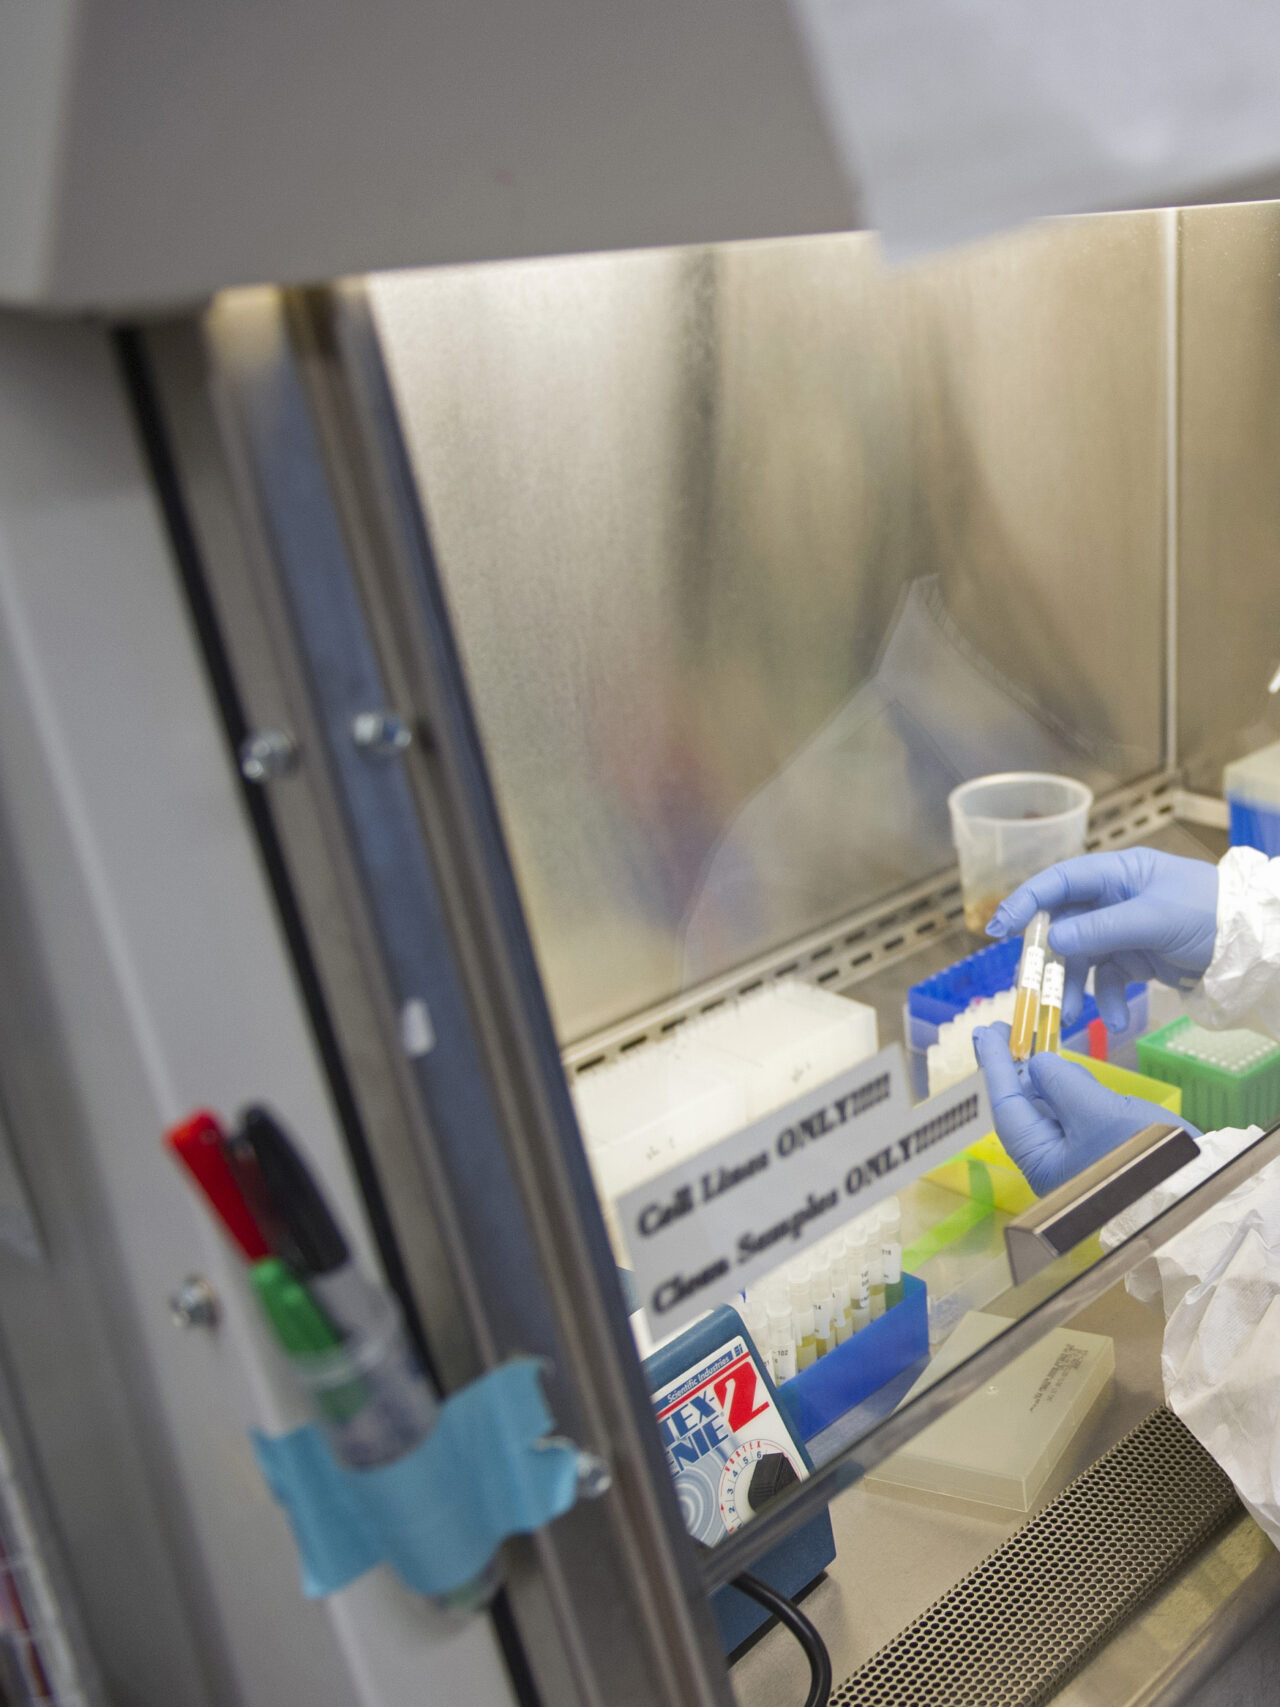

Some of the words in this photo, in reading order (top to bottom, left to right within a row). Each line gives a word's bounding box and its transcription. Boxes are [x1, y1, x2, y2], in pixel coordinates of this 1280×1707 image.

[637, 1184, 695, 1237] Cell
[701, 1150, 770, 1203] Lines
[652, 1257, 730, 1317] Clean
[737, 1188, 839, 1265] Samples
[667, 1378, 698, 1403] Scientific
[698, 1356, 730, 1382] Industries
[713, 1361, 770, 1433] 2
[743, 1456, 749, 1465] 5
[756, 1450, 762, 1459] 6
[732, 1470, 738, 1478] 4
[728, 1506, 736, 1514] 2
